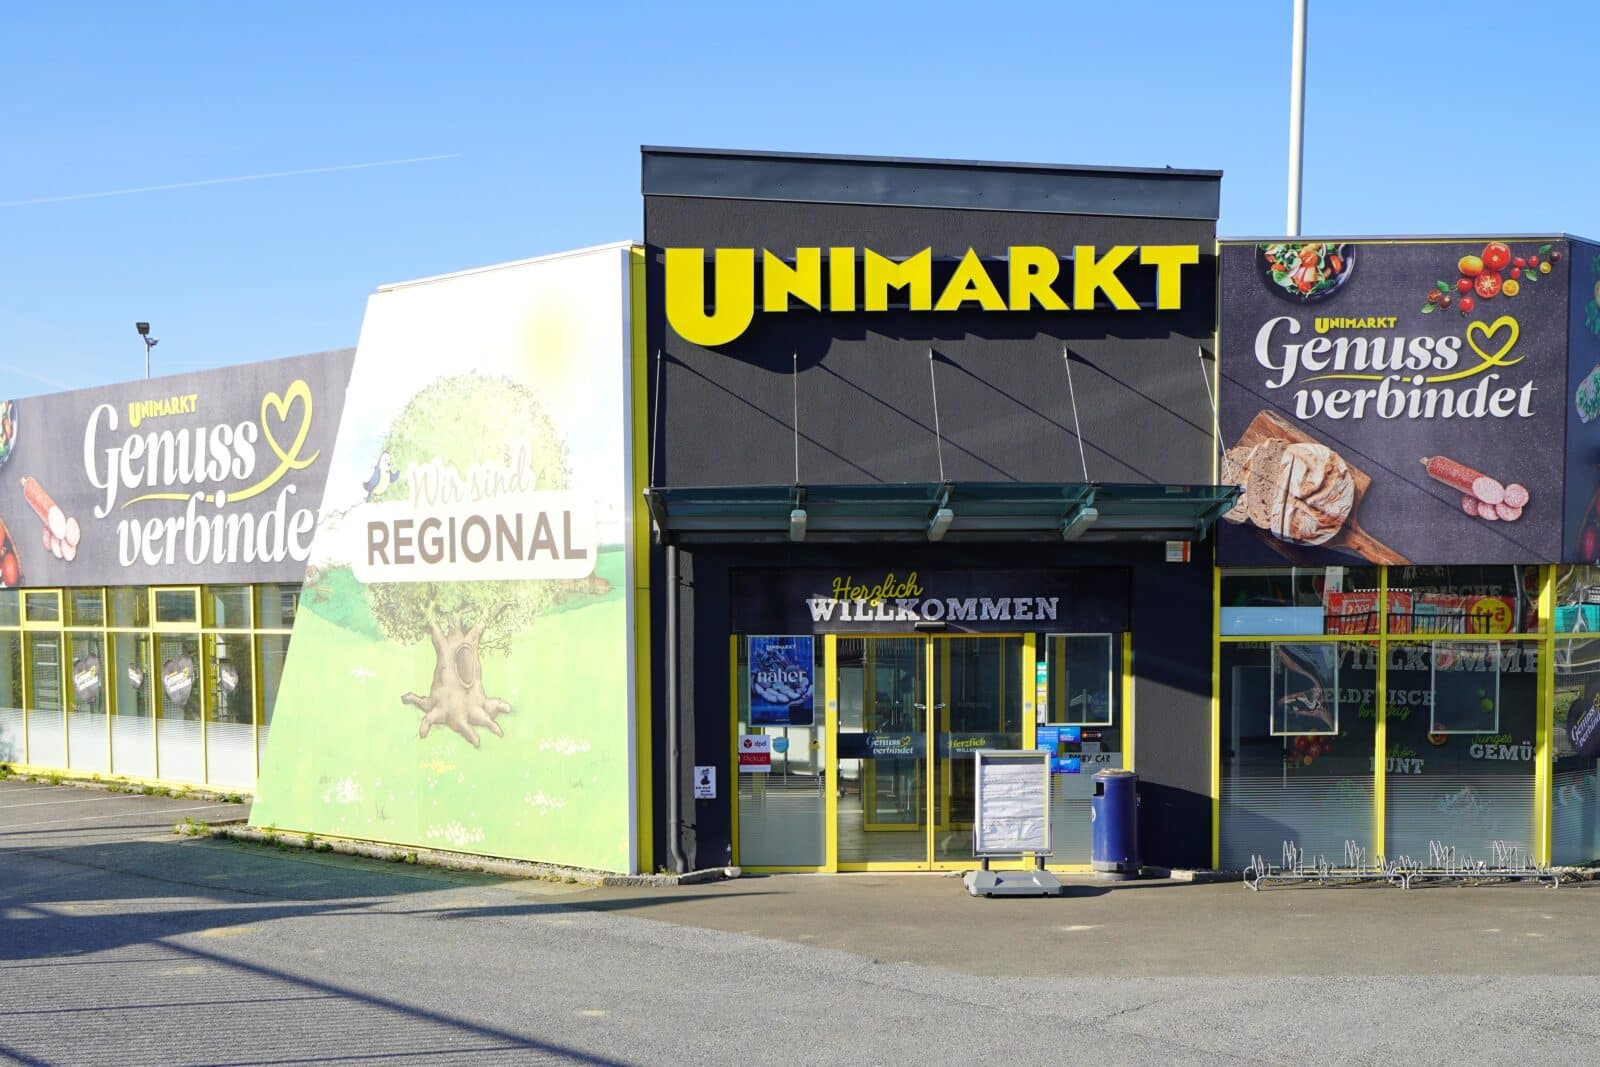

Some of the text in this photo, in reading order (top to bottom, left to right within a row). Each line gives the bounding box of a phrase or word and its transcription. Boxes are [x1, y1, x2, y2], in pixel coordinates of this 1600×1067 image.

[665, 245, 1199, 346] UNIMARKT
[1315, 317, 1397, 333] UNIMARKT
[1254, 316, 1462, 389] Genuss
[129, 394, 198, 428] UNIMARKT
[1294, 374, 1538, 420] verbindet
[84, 403, 258, 519] Genuss
[411, 445, 530, 509] Wir sind
[117, 484, 320, 567] verbinde
[367, 510, 588, 566] REGIONAL
[832, 571, 923, 606] Herzlich
[806, 597, 1060, 622] WILLKOMMEN
[757, 668, 807, 683] näher
[873, 747, 914, 755] verbindet
[1469, 741, 1558, 762] GEMÜ
